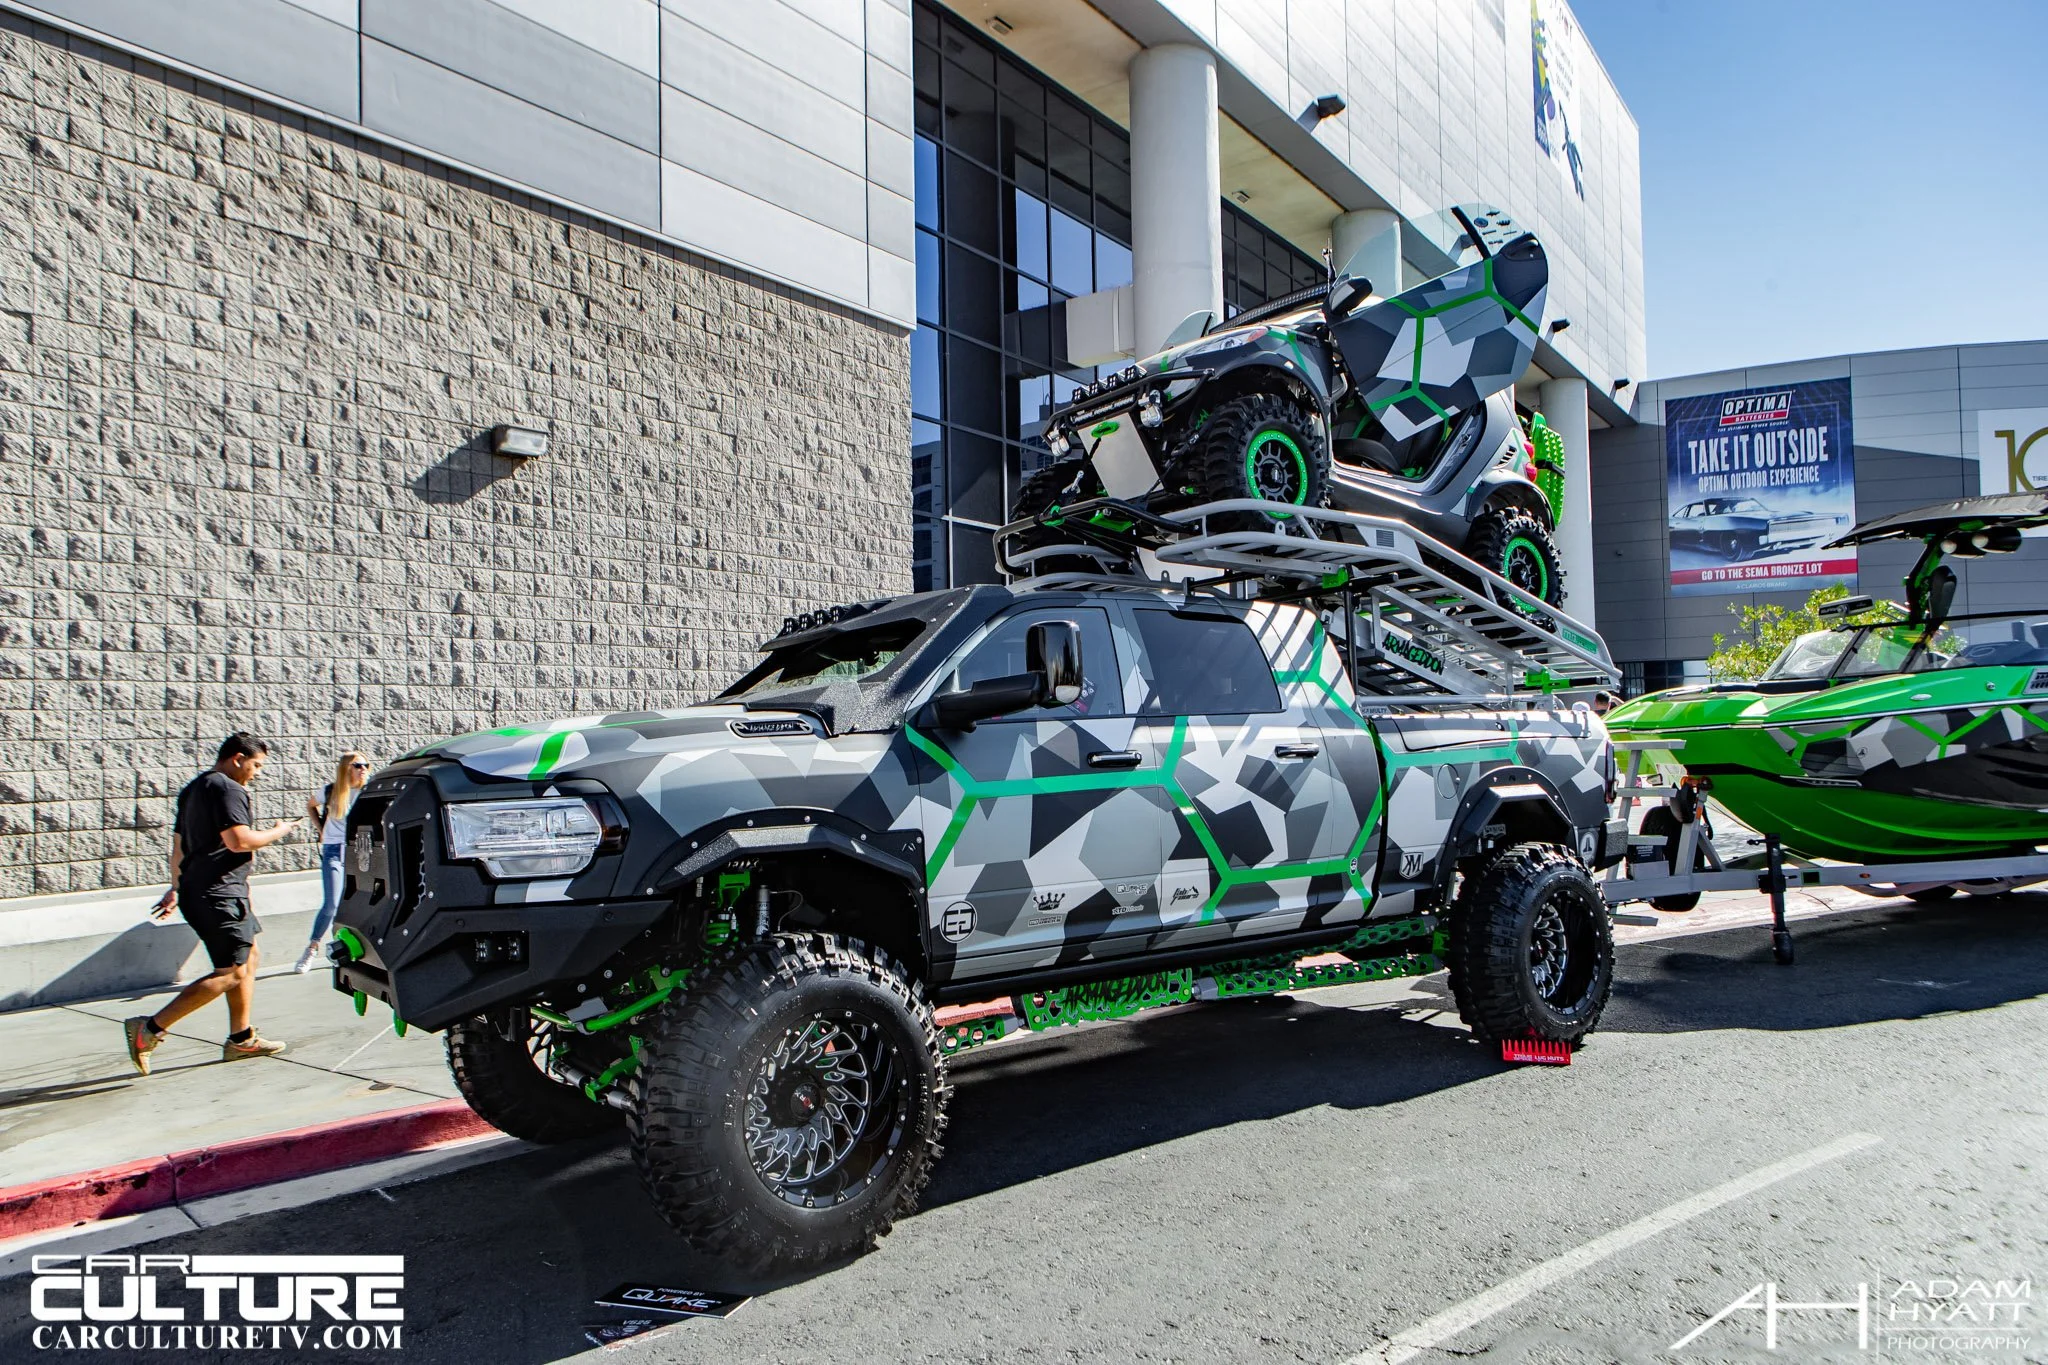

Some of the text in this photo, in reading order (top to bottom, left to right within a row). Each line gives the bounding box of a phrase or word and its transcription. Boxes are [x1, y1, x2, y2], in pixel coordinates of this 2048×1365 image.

[1724, 394, 1788, 415] OPTIMA
[1735, 413, 1774, 423] BATTERIES
[1751, 422, 1768, 430] POWER
[1688, 426, 1829, 474] TAKE IT OUTSIDE
[1698, 465, 1820, 493] OPTIMA OUTDOOR EXPERIENCE
[1701, 562, 1823, 581] GO TO THE SEMA BRONZE LOT
[621, 1288, 716, 1309] QUAKE
[656, 1287, 693, 1297] POWERED
